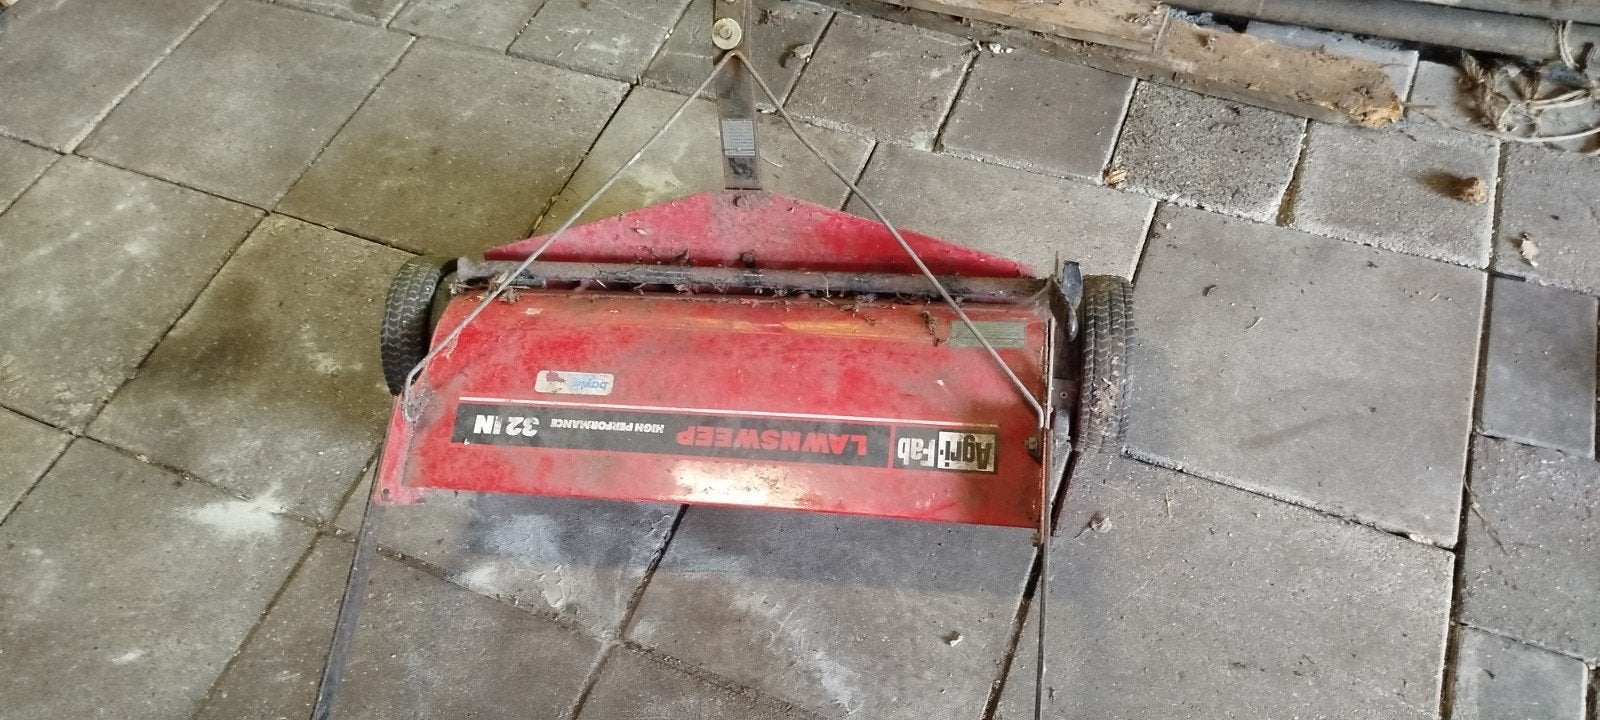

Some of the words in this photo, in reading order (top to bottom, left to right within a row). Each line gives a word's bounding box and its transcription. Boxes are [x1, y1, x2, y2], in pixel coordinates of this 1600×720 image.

[473, 414, 502, 435] IN
[505, 416, 540, 437] 32
[550, 418, 634, 432] PERFORMANCE
[635, 421, 665, 434] HIGH
[676, 425, 868, 456] LAWNSWEEP
